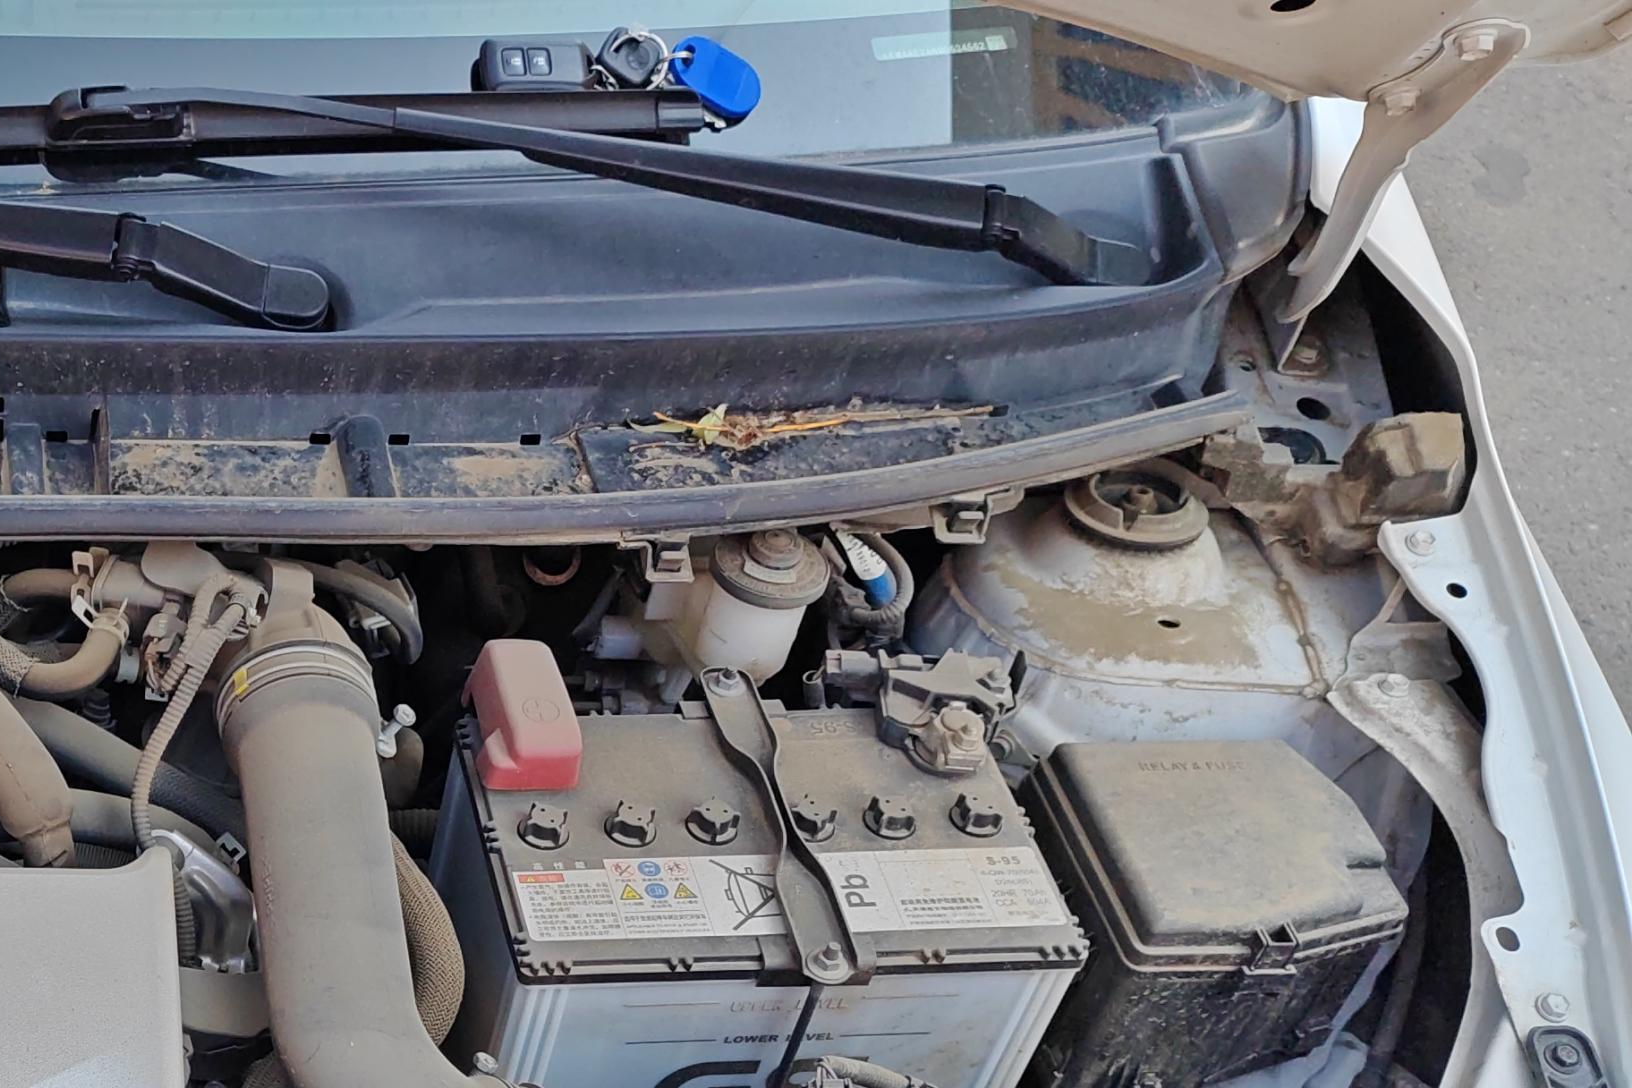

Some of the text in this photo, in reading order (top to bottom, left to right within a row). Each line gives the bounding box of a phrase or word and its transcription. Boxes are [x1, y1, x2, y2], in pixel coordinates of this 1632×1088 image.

[985, 855, 1021, 866] S-95
[840, 873, 877, 908] Pb
[723, 1034, 779, 1044] LOWER
